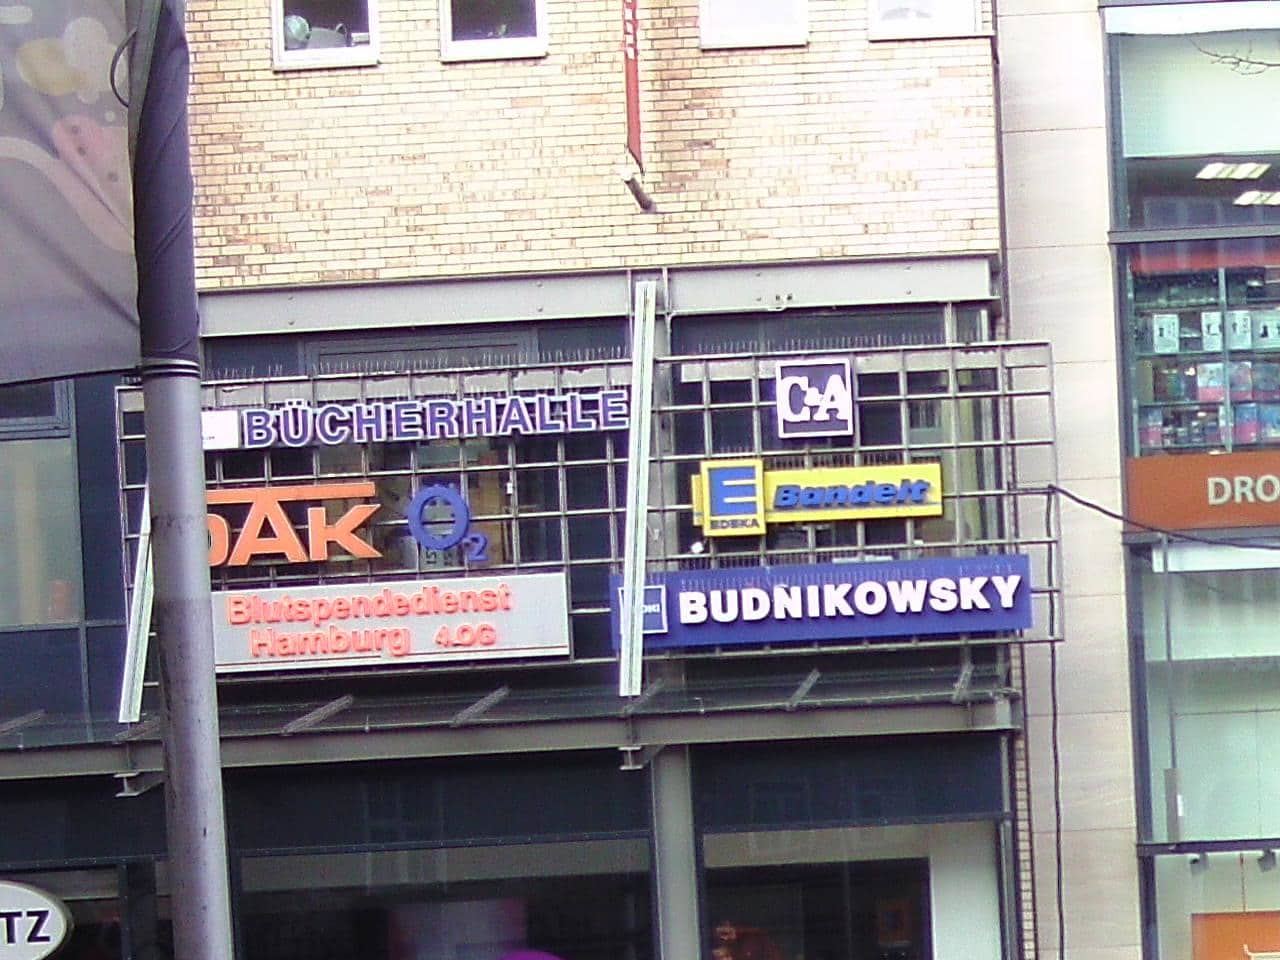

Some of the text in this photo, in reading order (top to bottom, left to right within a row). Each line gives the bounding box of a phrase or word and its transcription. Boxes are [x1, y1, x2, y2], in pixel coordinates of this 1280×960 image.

[781, 374, 849, 422] C&A
[242, 390, 632, 449] BÜCHERHALLE
[773, 479, 932, 510] Bandelt
[710, 519, 760, 530] EDEKA
[228, 584, 513, 626] Blutspendedienst
[679, 575, 1021, 624] BUDNIKOWSKY
[250, 625, 411, 658] Hamburg
